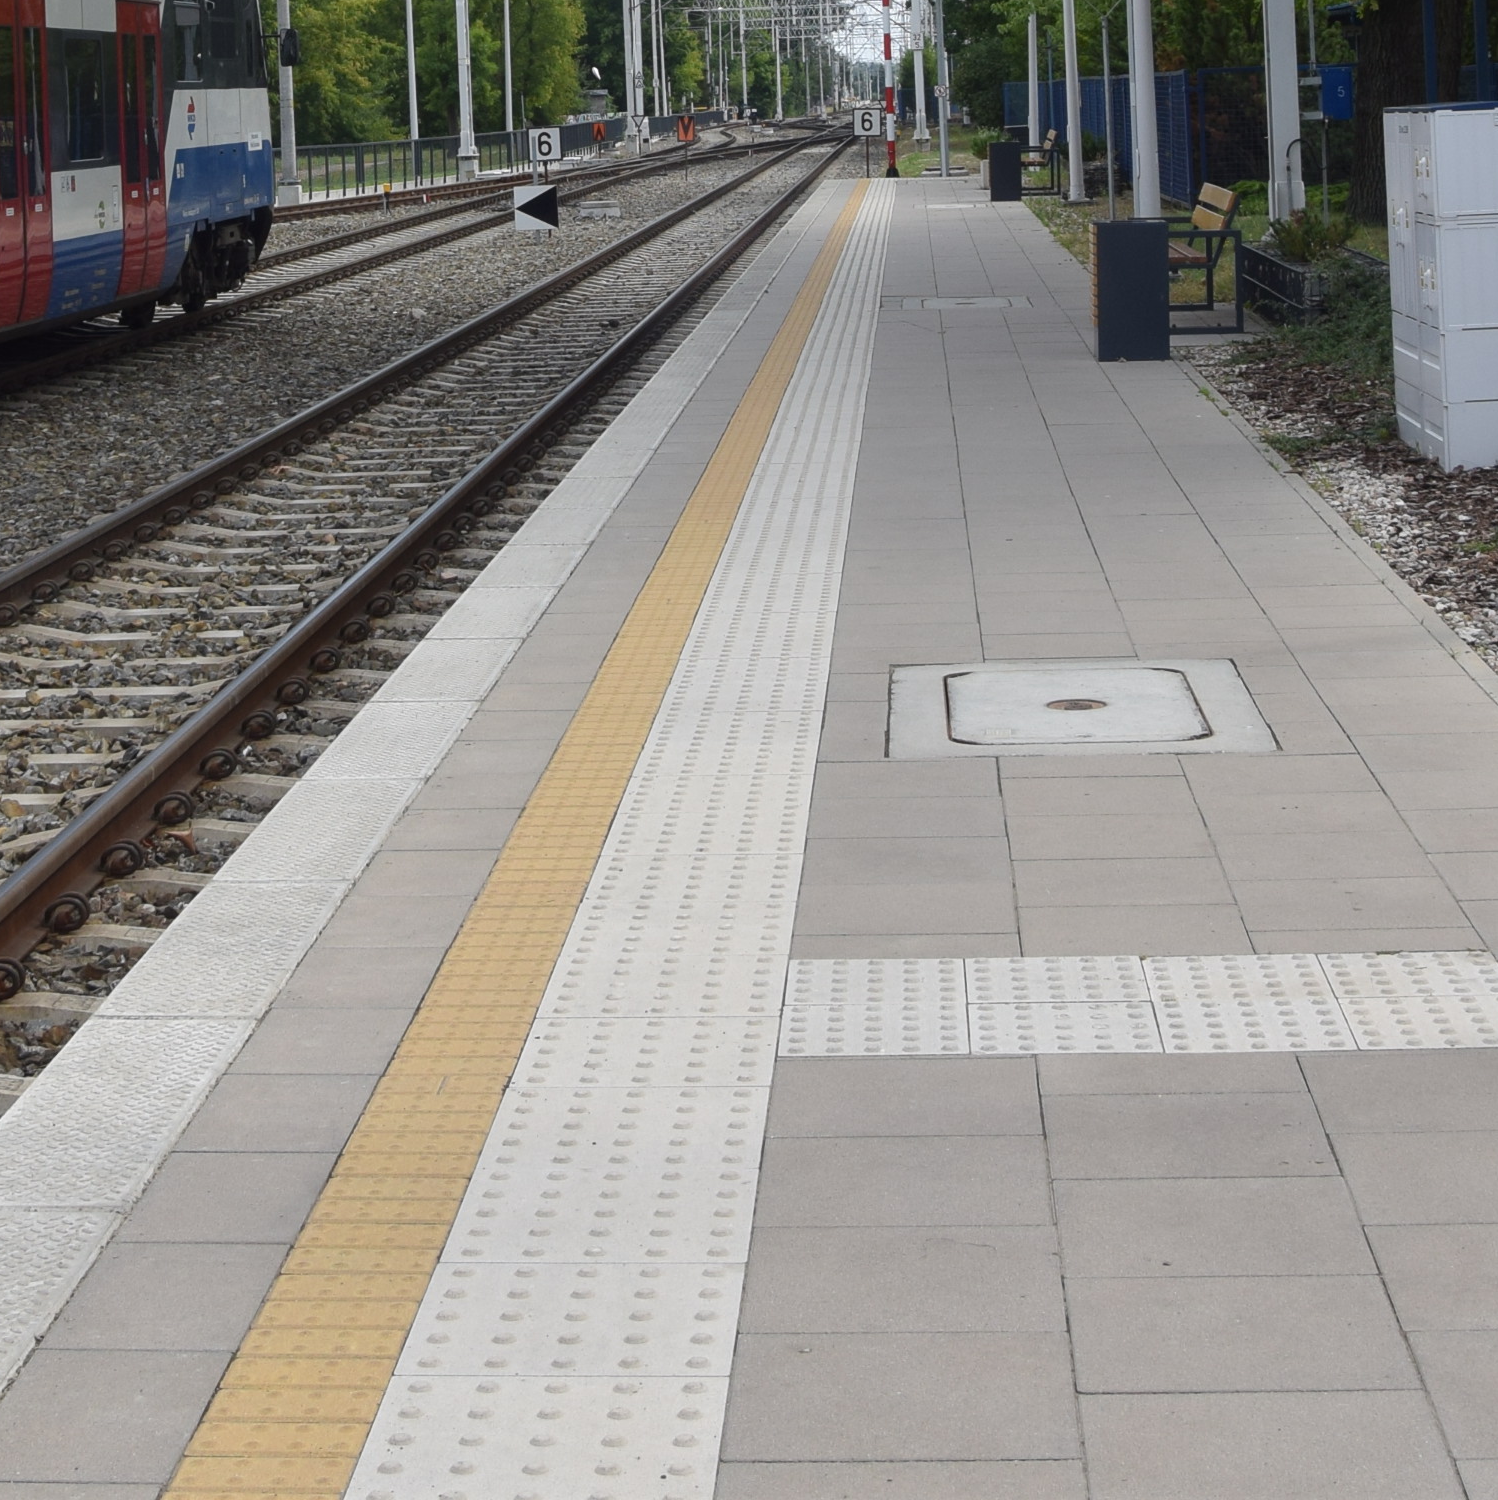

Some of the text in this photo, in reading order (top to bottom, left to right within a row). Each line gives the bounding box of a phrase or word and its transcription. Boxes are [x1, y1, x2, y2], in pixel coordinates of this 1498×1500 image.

[1337, 85, 1345, 98] 5
[860, 111, 874, 132] 6
[535, 130, 552, 157] 6
